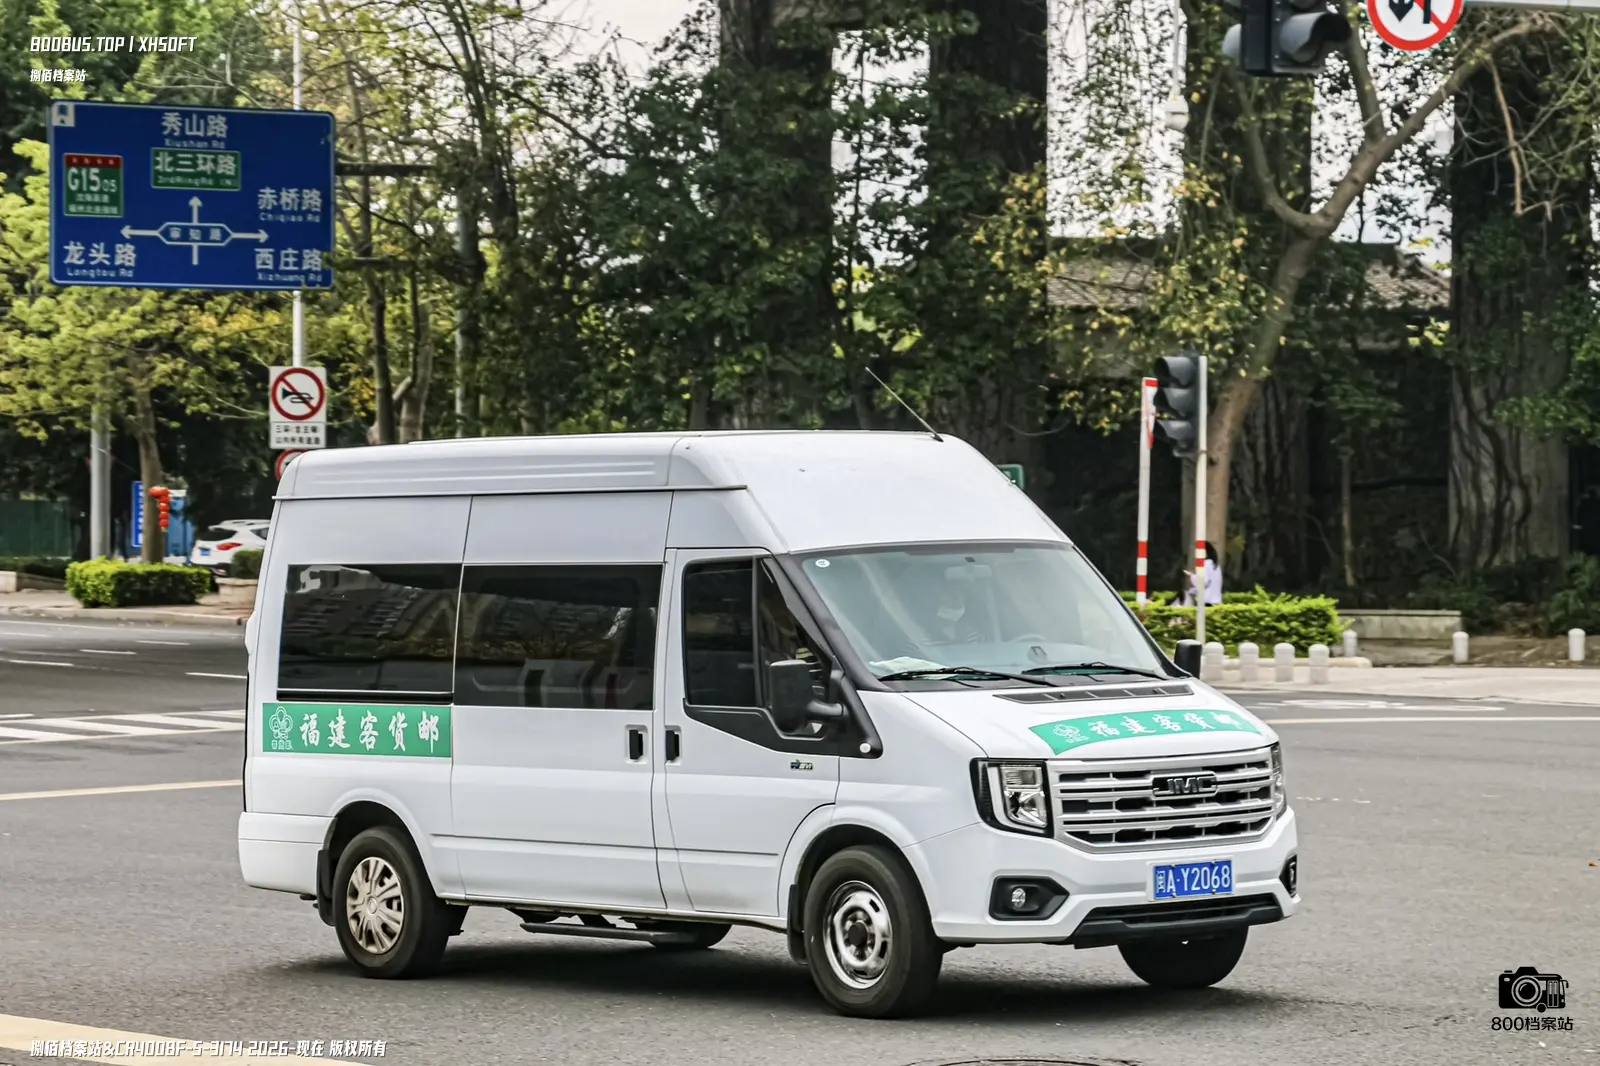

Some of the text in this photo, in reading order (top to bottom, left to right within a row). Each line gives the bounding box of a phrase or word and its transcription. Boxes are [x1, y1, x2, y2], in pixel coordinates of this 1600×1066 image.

[161, 112, 228, 138] 秀山路
[154, 151, 237, 175] 北三环路
[257, 186, 322, 212] 赤桥路
[63, 240, 136, 267] 龙头路
[254, 248, 322, 271] 西庄路
[299, 708, 439, 753] 福建客货邮
[1153, 776, 1217, 796] JMC
